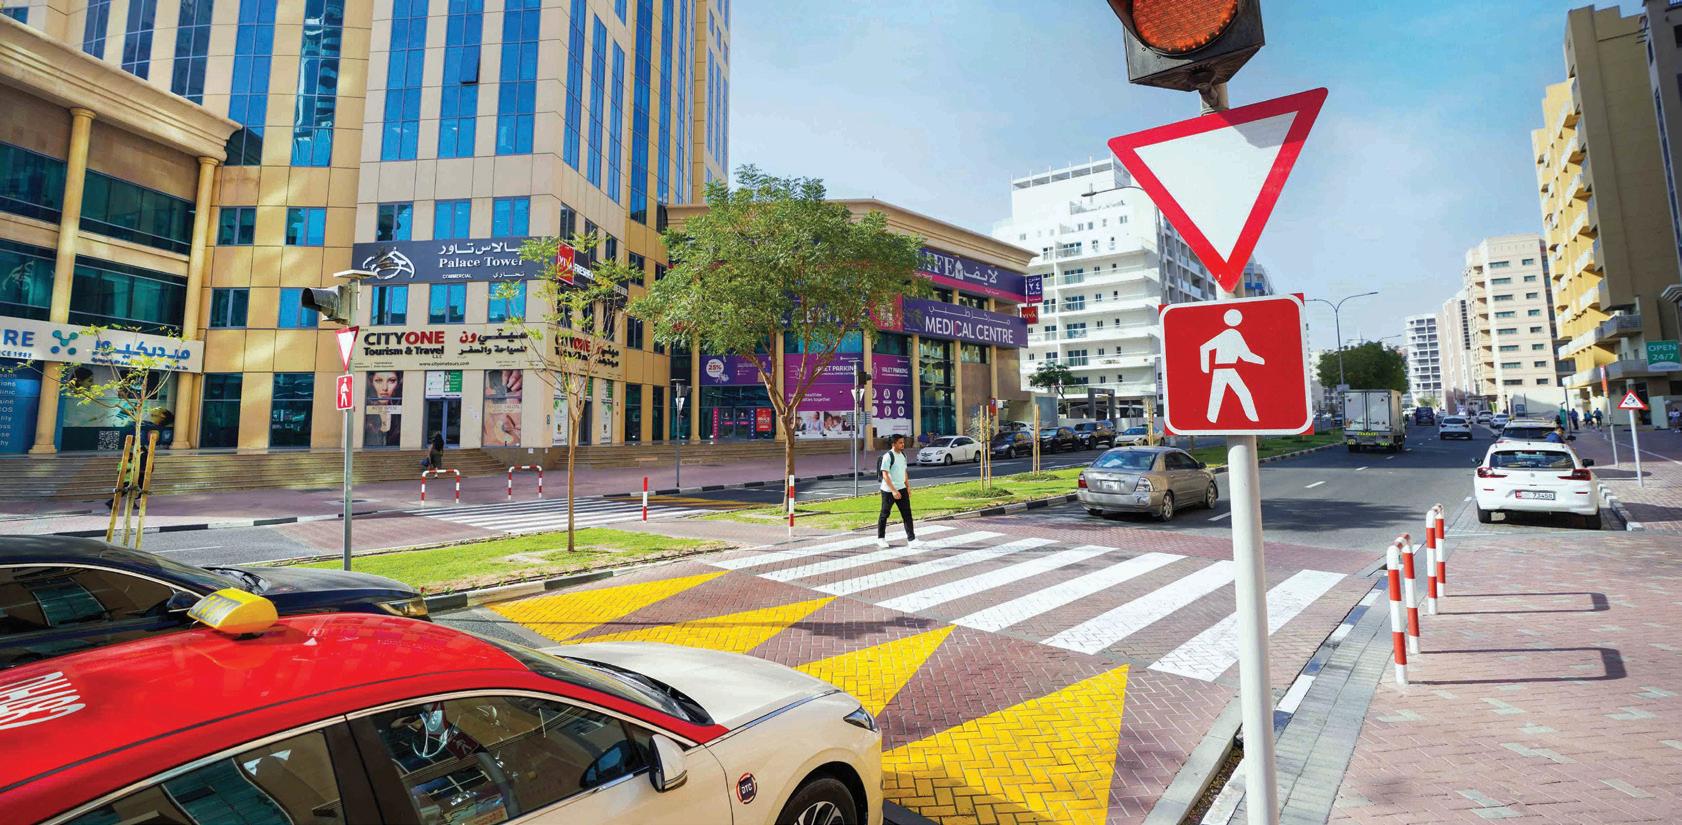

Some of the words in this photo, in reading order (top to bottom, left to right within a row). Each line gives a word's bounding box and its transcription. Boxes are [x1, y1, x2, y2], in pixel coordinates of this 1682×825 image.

[439, 258, 481, 268] Palace
[484, 256, 523, 267] Tower
[963, 266, 998, 286] لايف
[1022, 311, 1036, 319] VIVA
[925, 316, 975, 339] MEDICAL
[976, 325, 1014, 344] CENTRE
[363, 330, 445, 346] CITYONE
[363, 346, 403, 356] Tourism
[404, 346, 413, 355] &
[414, 345, 444, 355] Travel
[1652, 353, 1674, 361] 24/7
[741, 783, 753, 794] DTC
